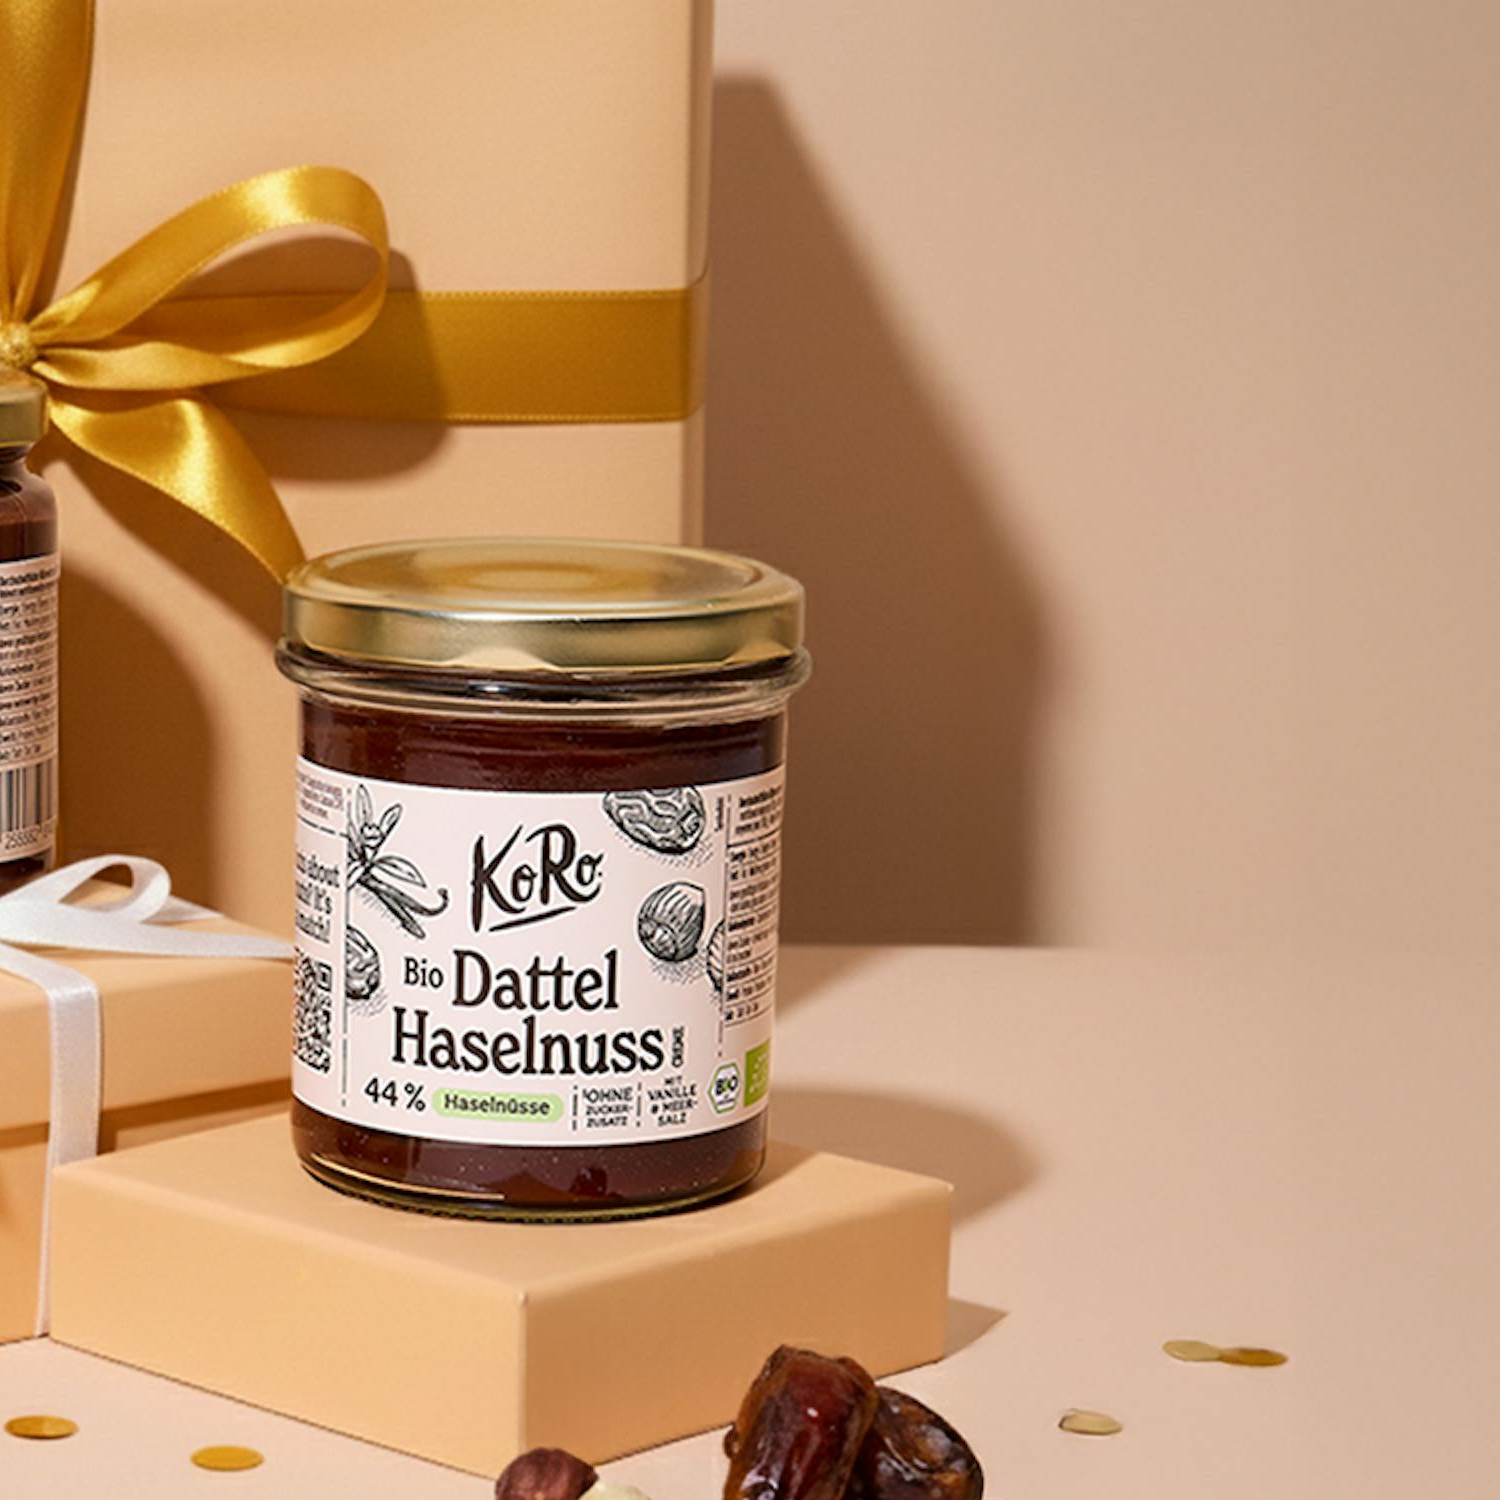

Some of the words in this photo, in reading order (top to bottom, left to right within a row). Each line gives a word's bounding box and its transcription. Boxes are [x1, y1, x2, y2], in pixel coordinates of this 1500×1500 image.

[469, 823, 605, 933] KoRo
[403, 956, 445, 990] Bio
[451, 947, 620, 1010] Dattel
[391, 1006, 664, 1076] Haselnuss
[364, 1076, 399, 1108] 44
[647, 1084, 697, 1101] VANILLE
[664, 1075, 683, 1086] MIT
[444, 1092, 551, 1116] Haselnüsse
[586, 1115, 629, 1129] ZUSATZ
[657, 1112, 687, 1127] SALZ
